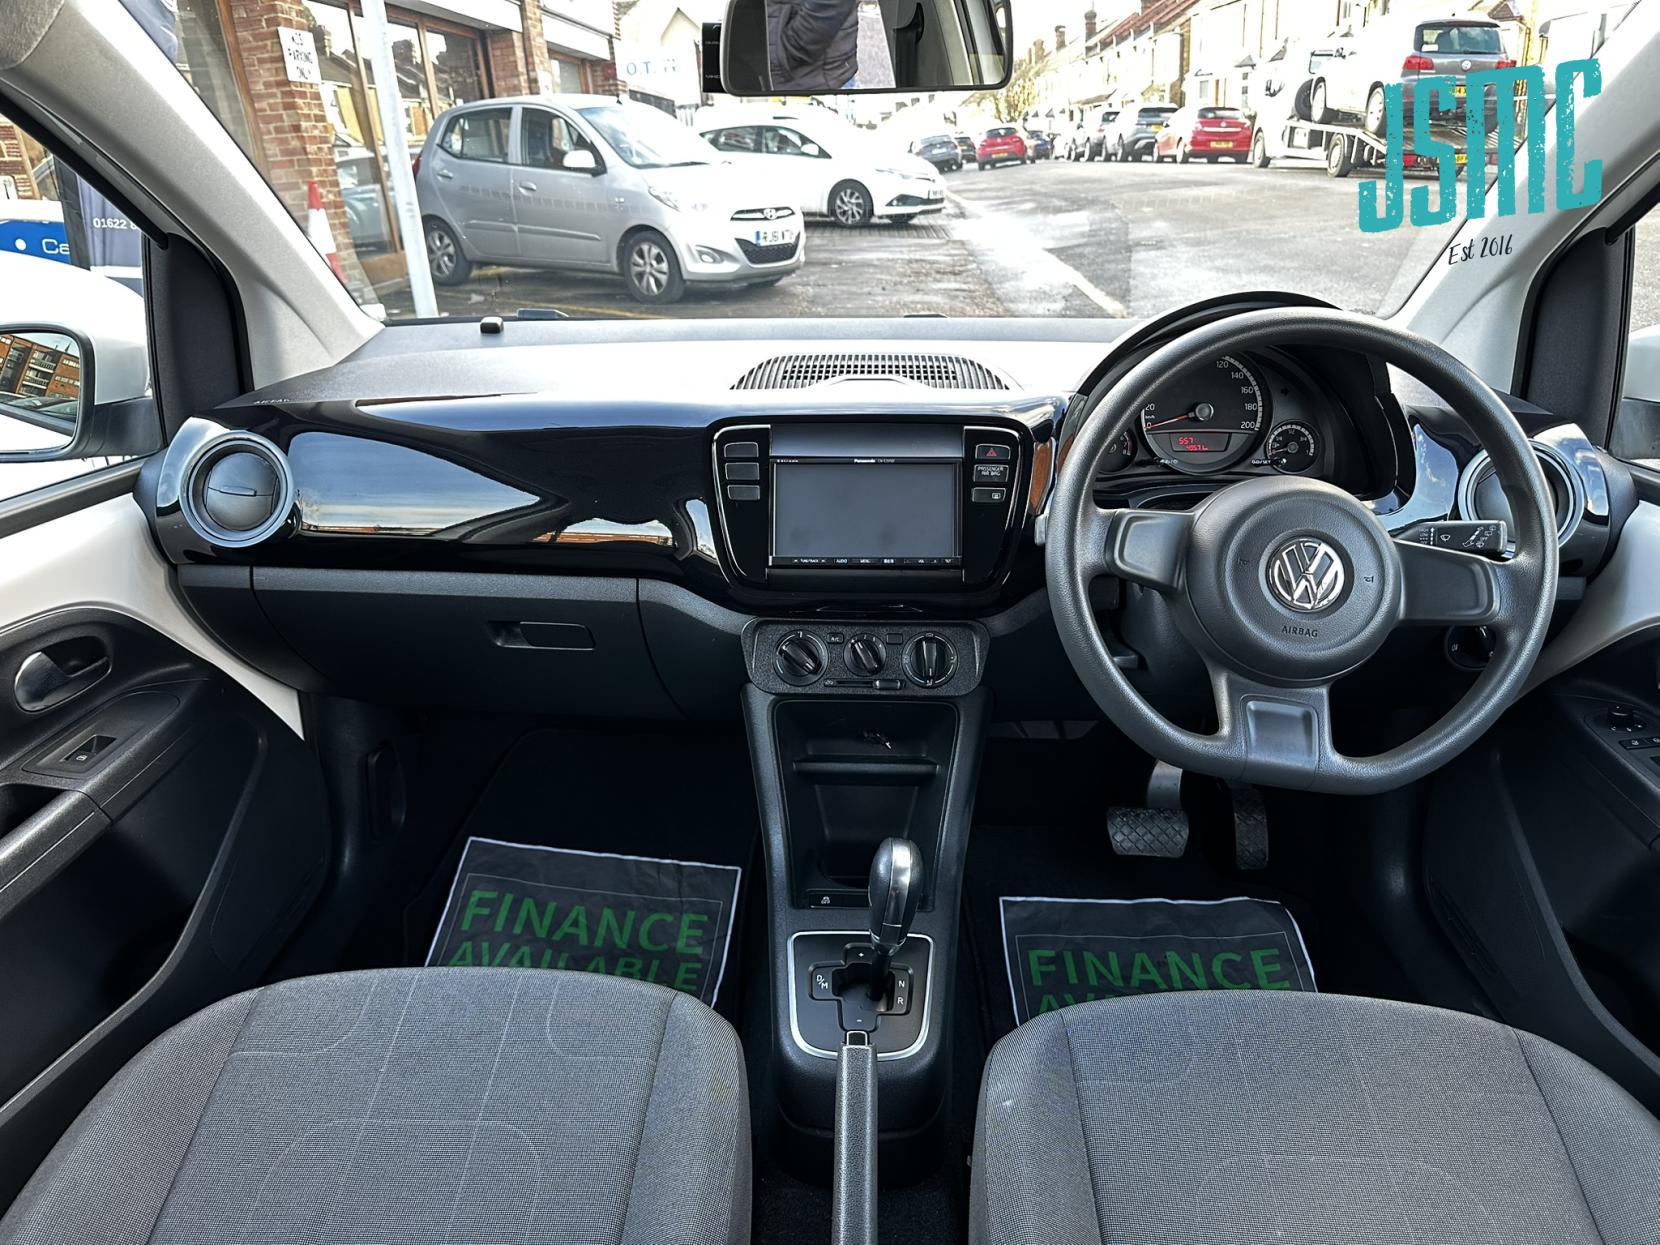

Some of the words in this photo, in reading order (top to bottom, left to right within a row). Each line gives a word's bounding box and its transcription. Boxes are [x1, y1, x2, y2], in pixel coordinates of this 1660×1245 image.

[92, 217, 128, 230] 01622
[1216, 360, 1229, 369] 120
[1231, 371, 1244, 380] 140
[1241, 386, 1254, 394] 160
[1244, 403, 1258, 411] 180
[1240, 421, 1255, 429] 200
[1281, 625, 1318, 638] AIRBAG
[460, 889, 709, 954] FINANCE
[1028, 948, 1291, 990] FINANCE
[898, 980, 905, 988] N
[897, 997, 904, 1005] R
